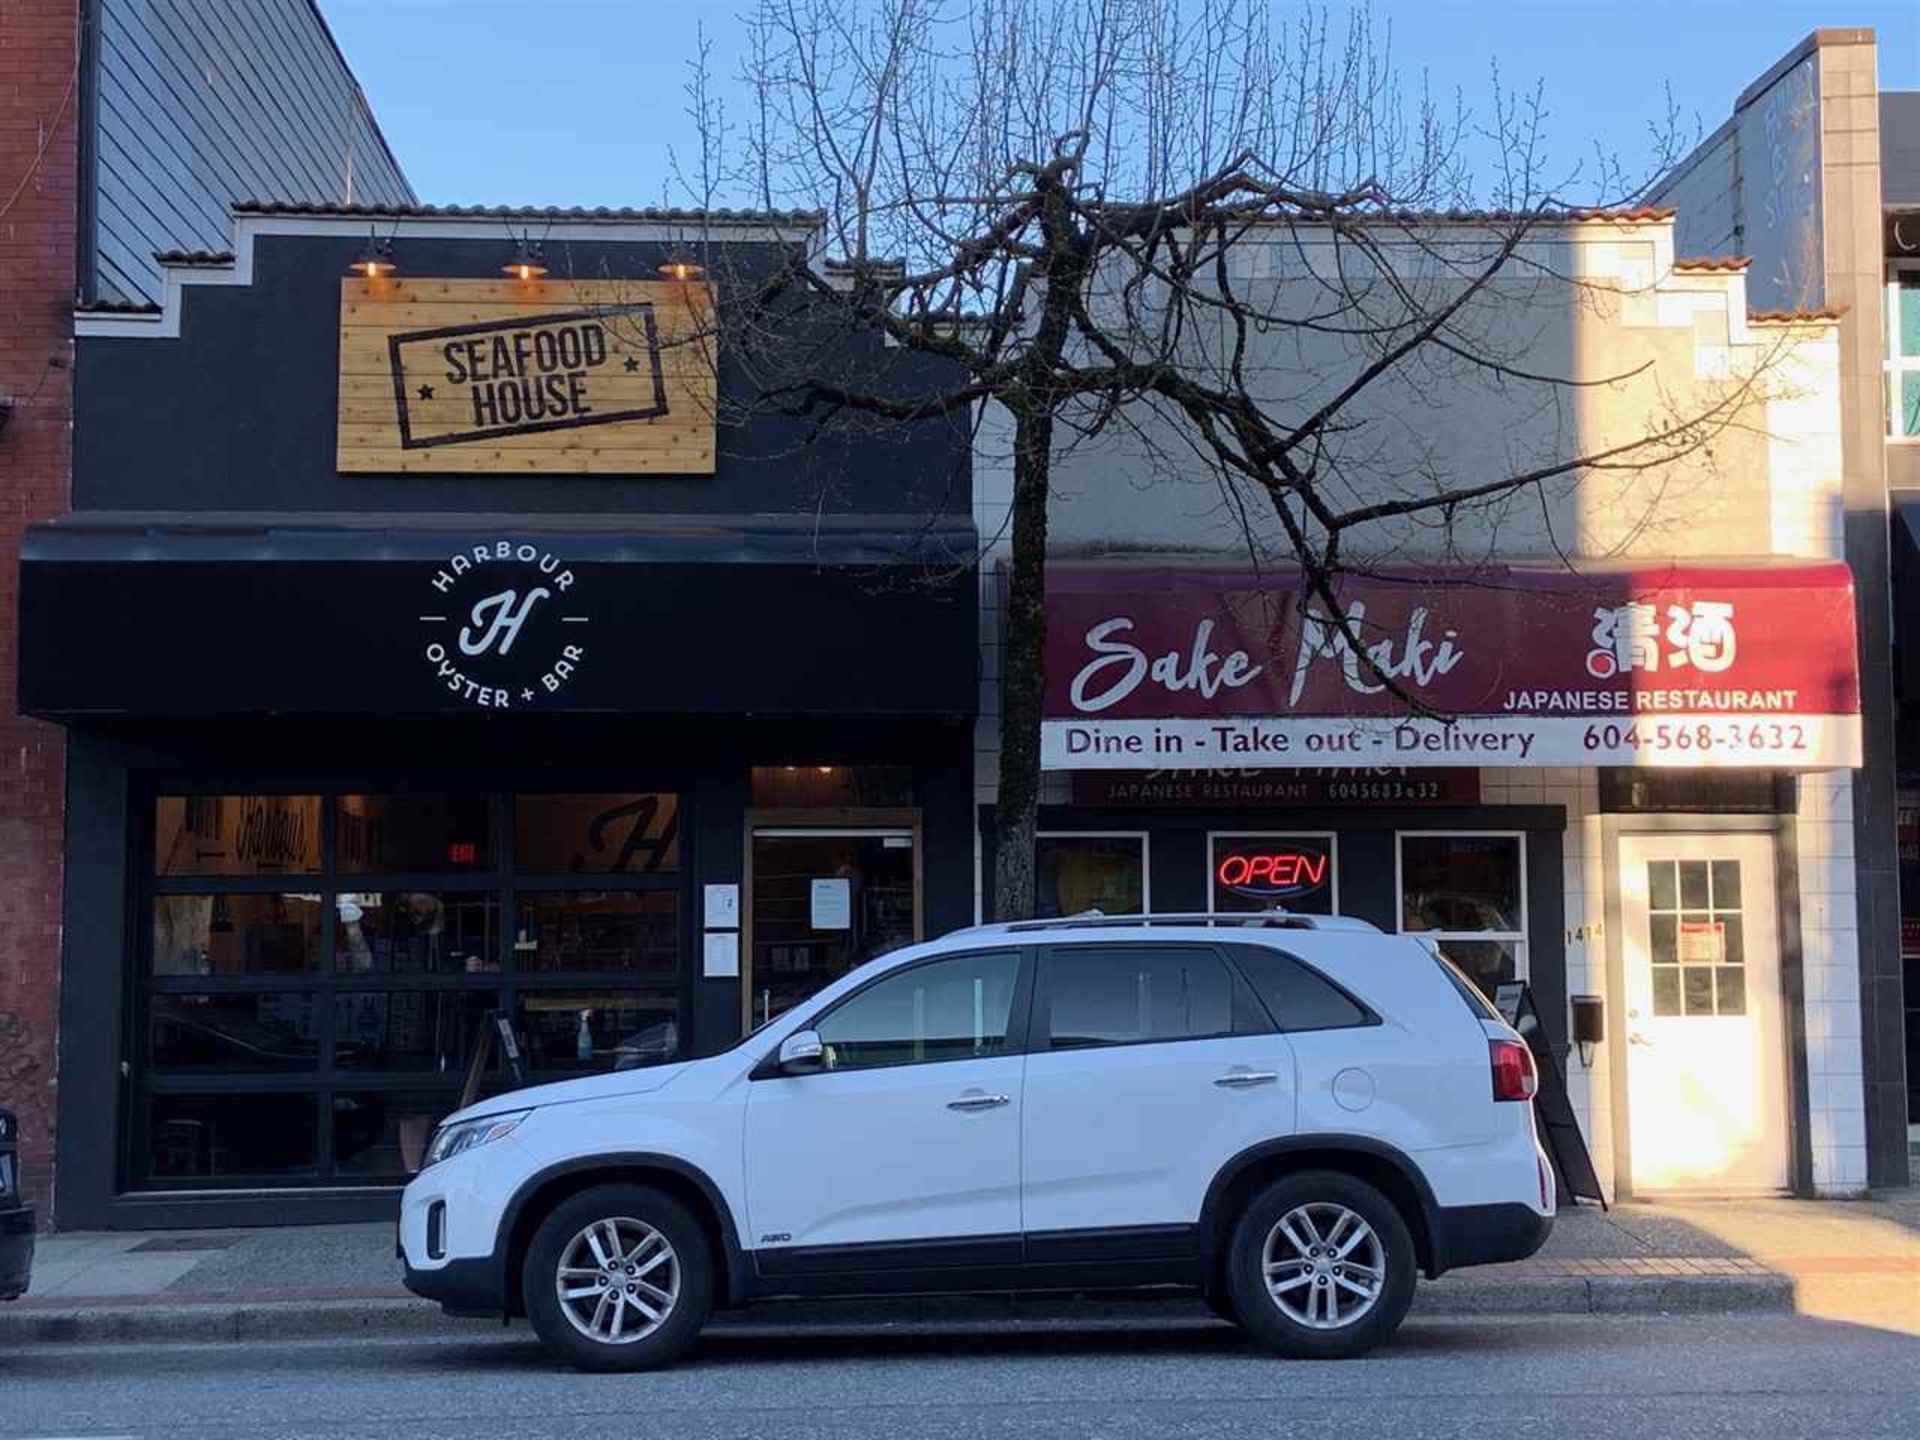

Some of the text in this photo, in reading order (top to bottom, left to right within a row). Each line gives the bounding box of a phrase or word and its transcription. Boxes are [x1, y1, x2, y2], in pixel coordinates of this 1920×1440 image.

[444, 324, 607, 384] SEAFOOD
[472, 371, 592, 427] HOUSE
[431, 541, 576, 593] HARBOUR
[1070, 598, 1466, 713] Sake Maki
[1586, 600, 1737, 679] 清酒
[426, 643, 510, 709] OYSTER
[541, 644, 584, 694] BAR
[1504, 689, 1798, 710] JAPANESE RESTAURANT
[1066, 726, 1142, 754] Dine
[1154, 726, 1183, 753] in
[1212, 726, 1290, 753] Take
[1305, 729, 1362, 751] out
[1395, 724, 1536, 758] Delivery
[1583, 724, 1808, 751] 604-568-3632
[1105, 782, 1193, 800] JAPANESE
[1202, 782, 1310, 800] RESTAURANT
[1216, 854, 1330, 887] OPEN
